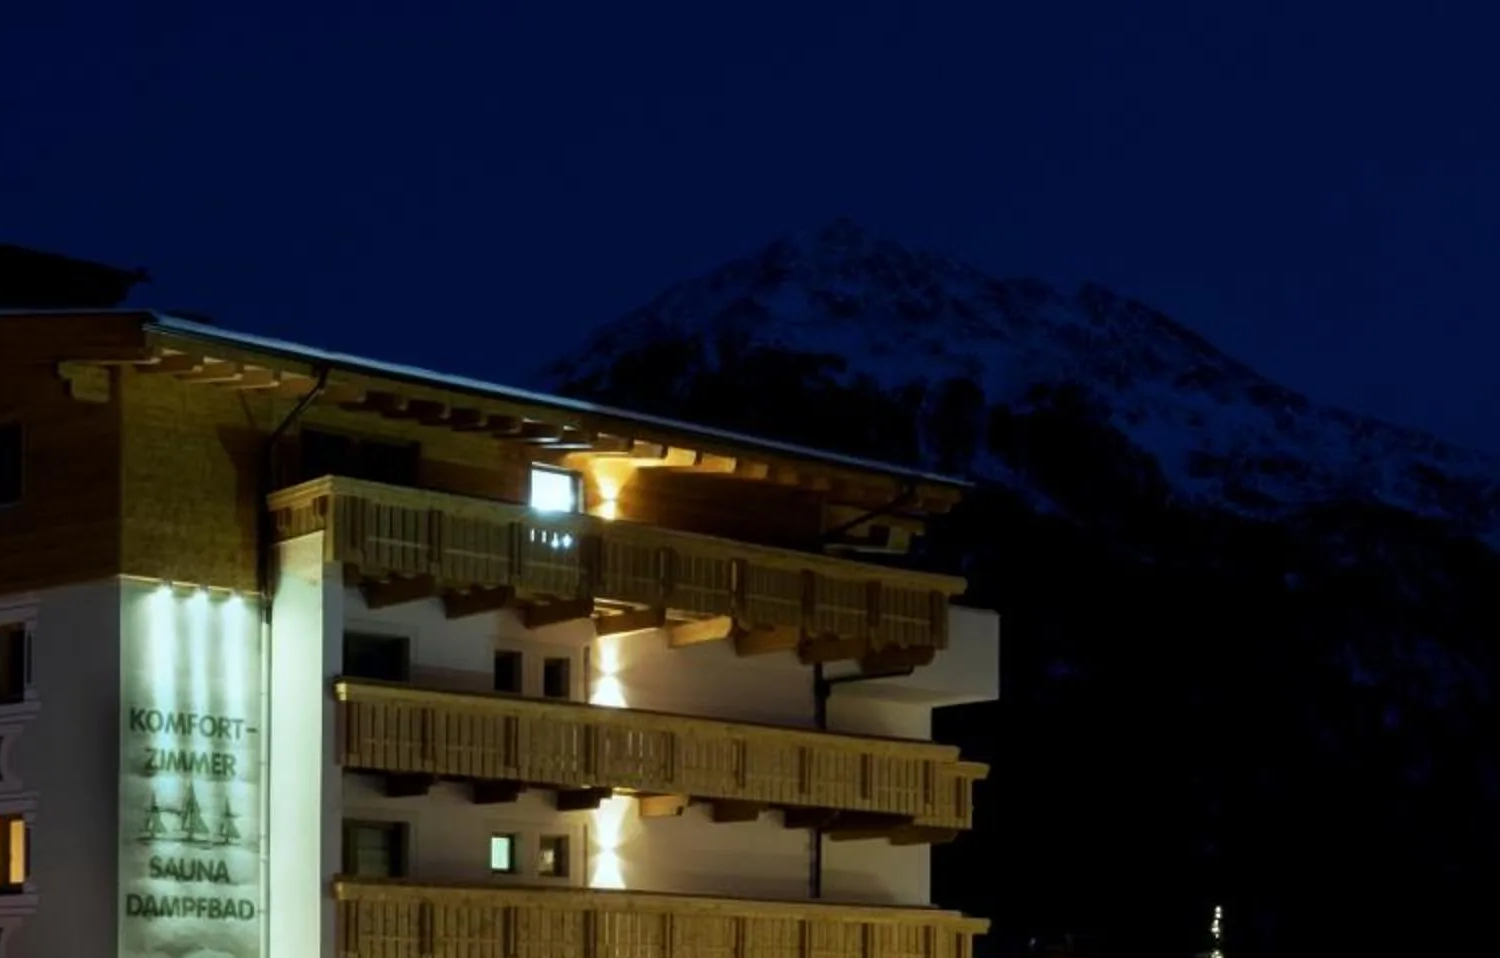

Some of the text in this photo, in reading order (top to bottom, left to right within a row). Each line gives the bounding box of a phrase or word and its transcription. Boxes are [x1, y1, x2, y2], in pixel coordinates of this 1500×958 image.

[130, 708, 258, 739] KOMFORT-
[145, 748, 236, 776] ZIMMER
[148, 857, 230, 884] SAUNA
[127, 893, 254, 922] DAMPFBAD
